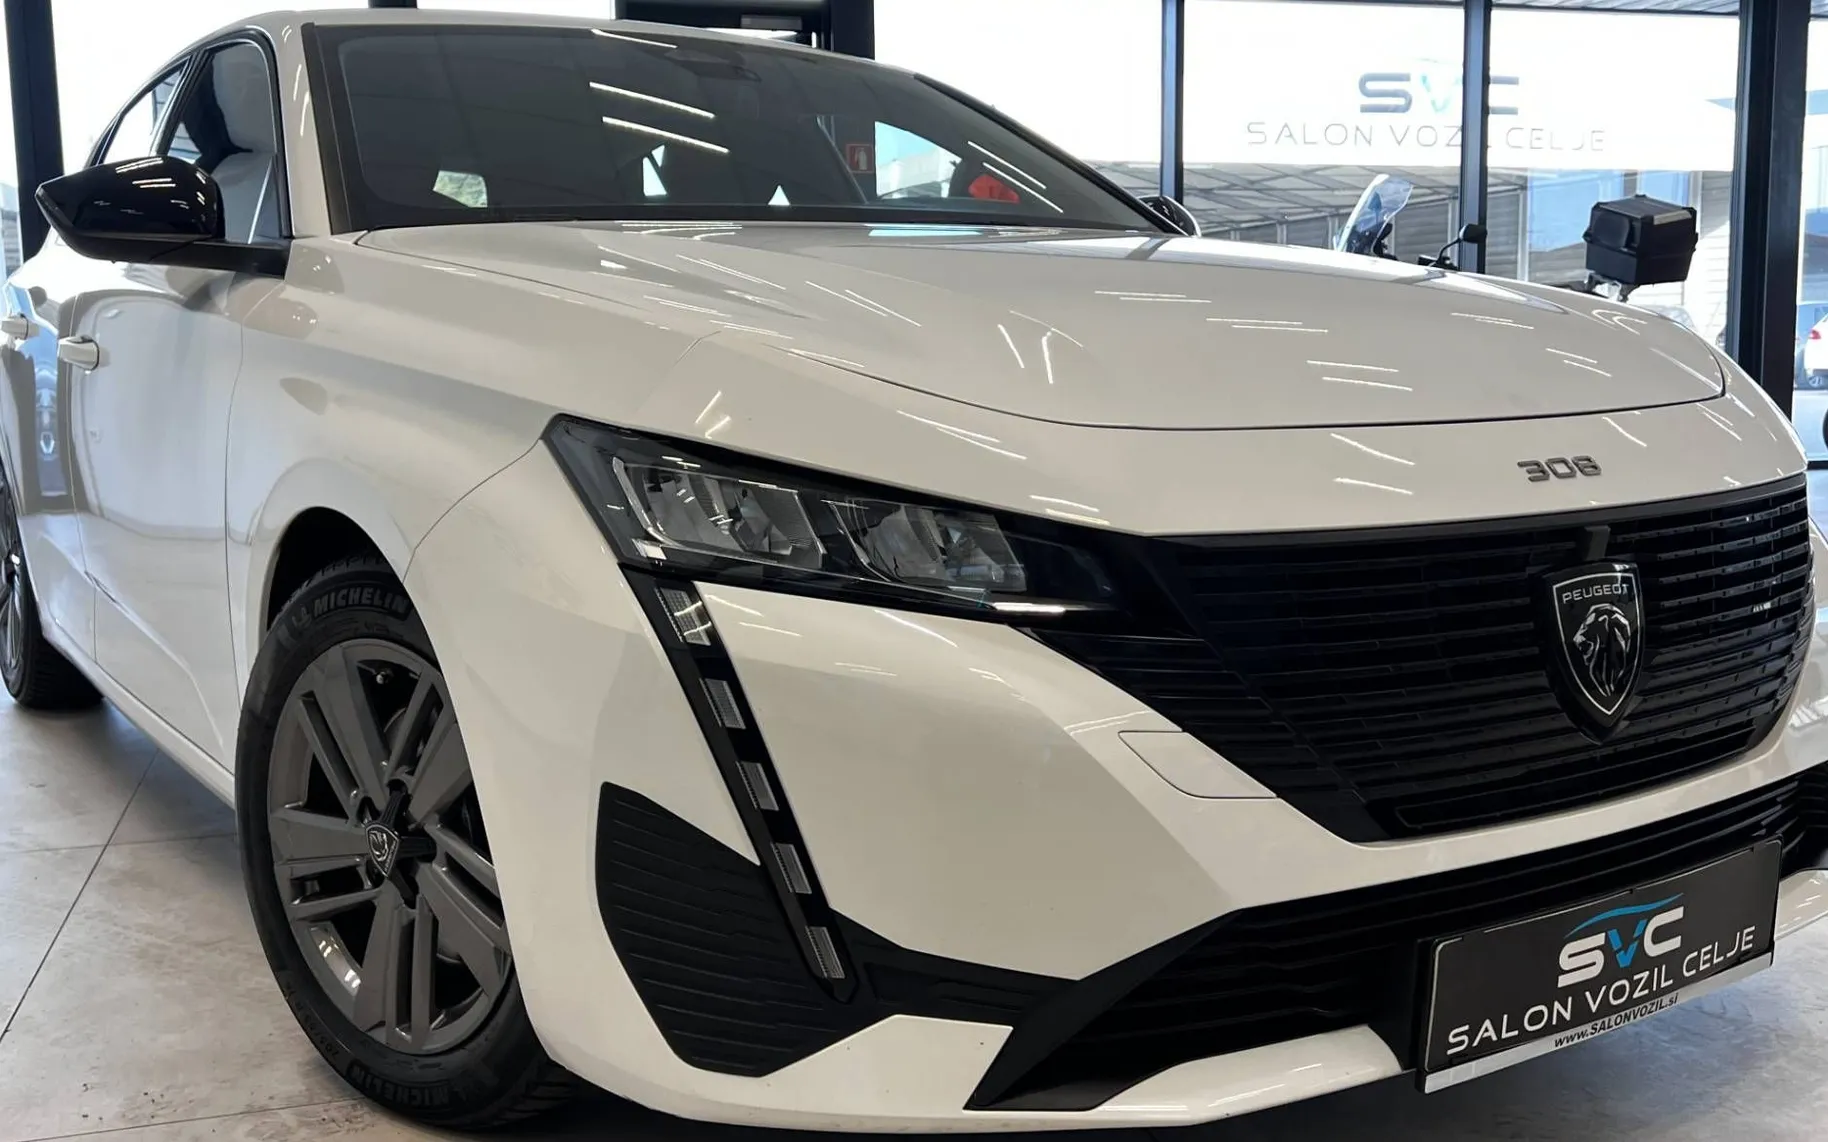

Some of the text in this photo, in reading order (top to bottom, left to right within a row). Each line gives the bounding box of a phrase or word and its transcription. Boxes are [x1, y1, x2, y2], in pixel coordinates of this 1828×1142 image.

[1247, 121, 1606, 151] SALON VOZ CELJE
[1517, 455, 1602, 482] 308
[314, 586, 411, 617] MICHELIN
[1561, 583, 1630, 604] PEUGEOT
[1557, 905, 1684, 988] SVC
[1446, 925, 1757, 1055] SALON VOZIL CELJE
[1553, 993, 1679, 1048] www.SALONVOZIL.si
[347, 1060, 450, 1108] MICHELIN
